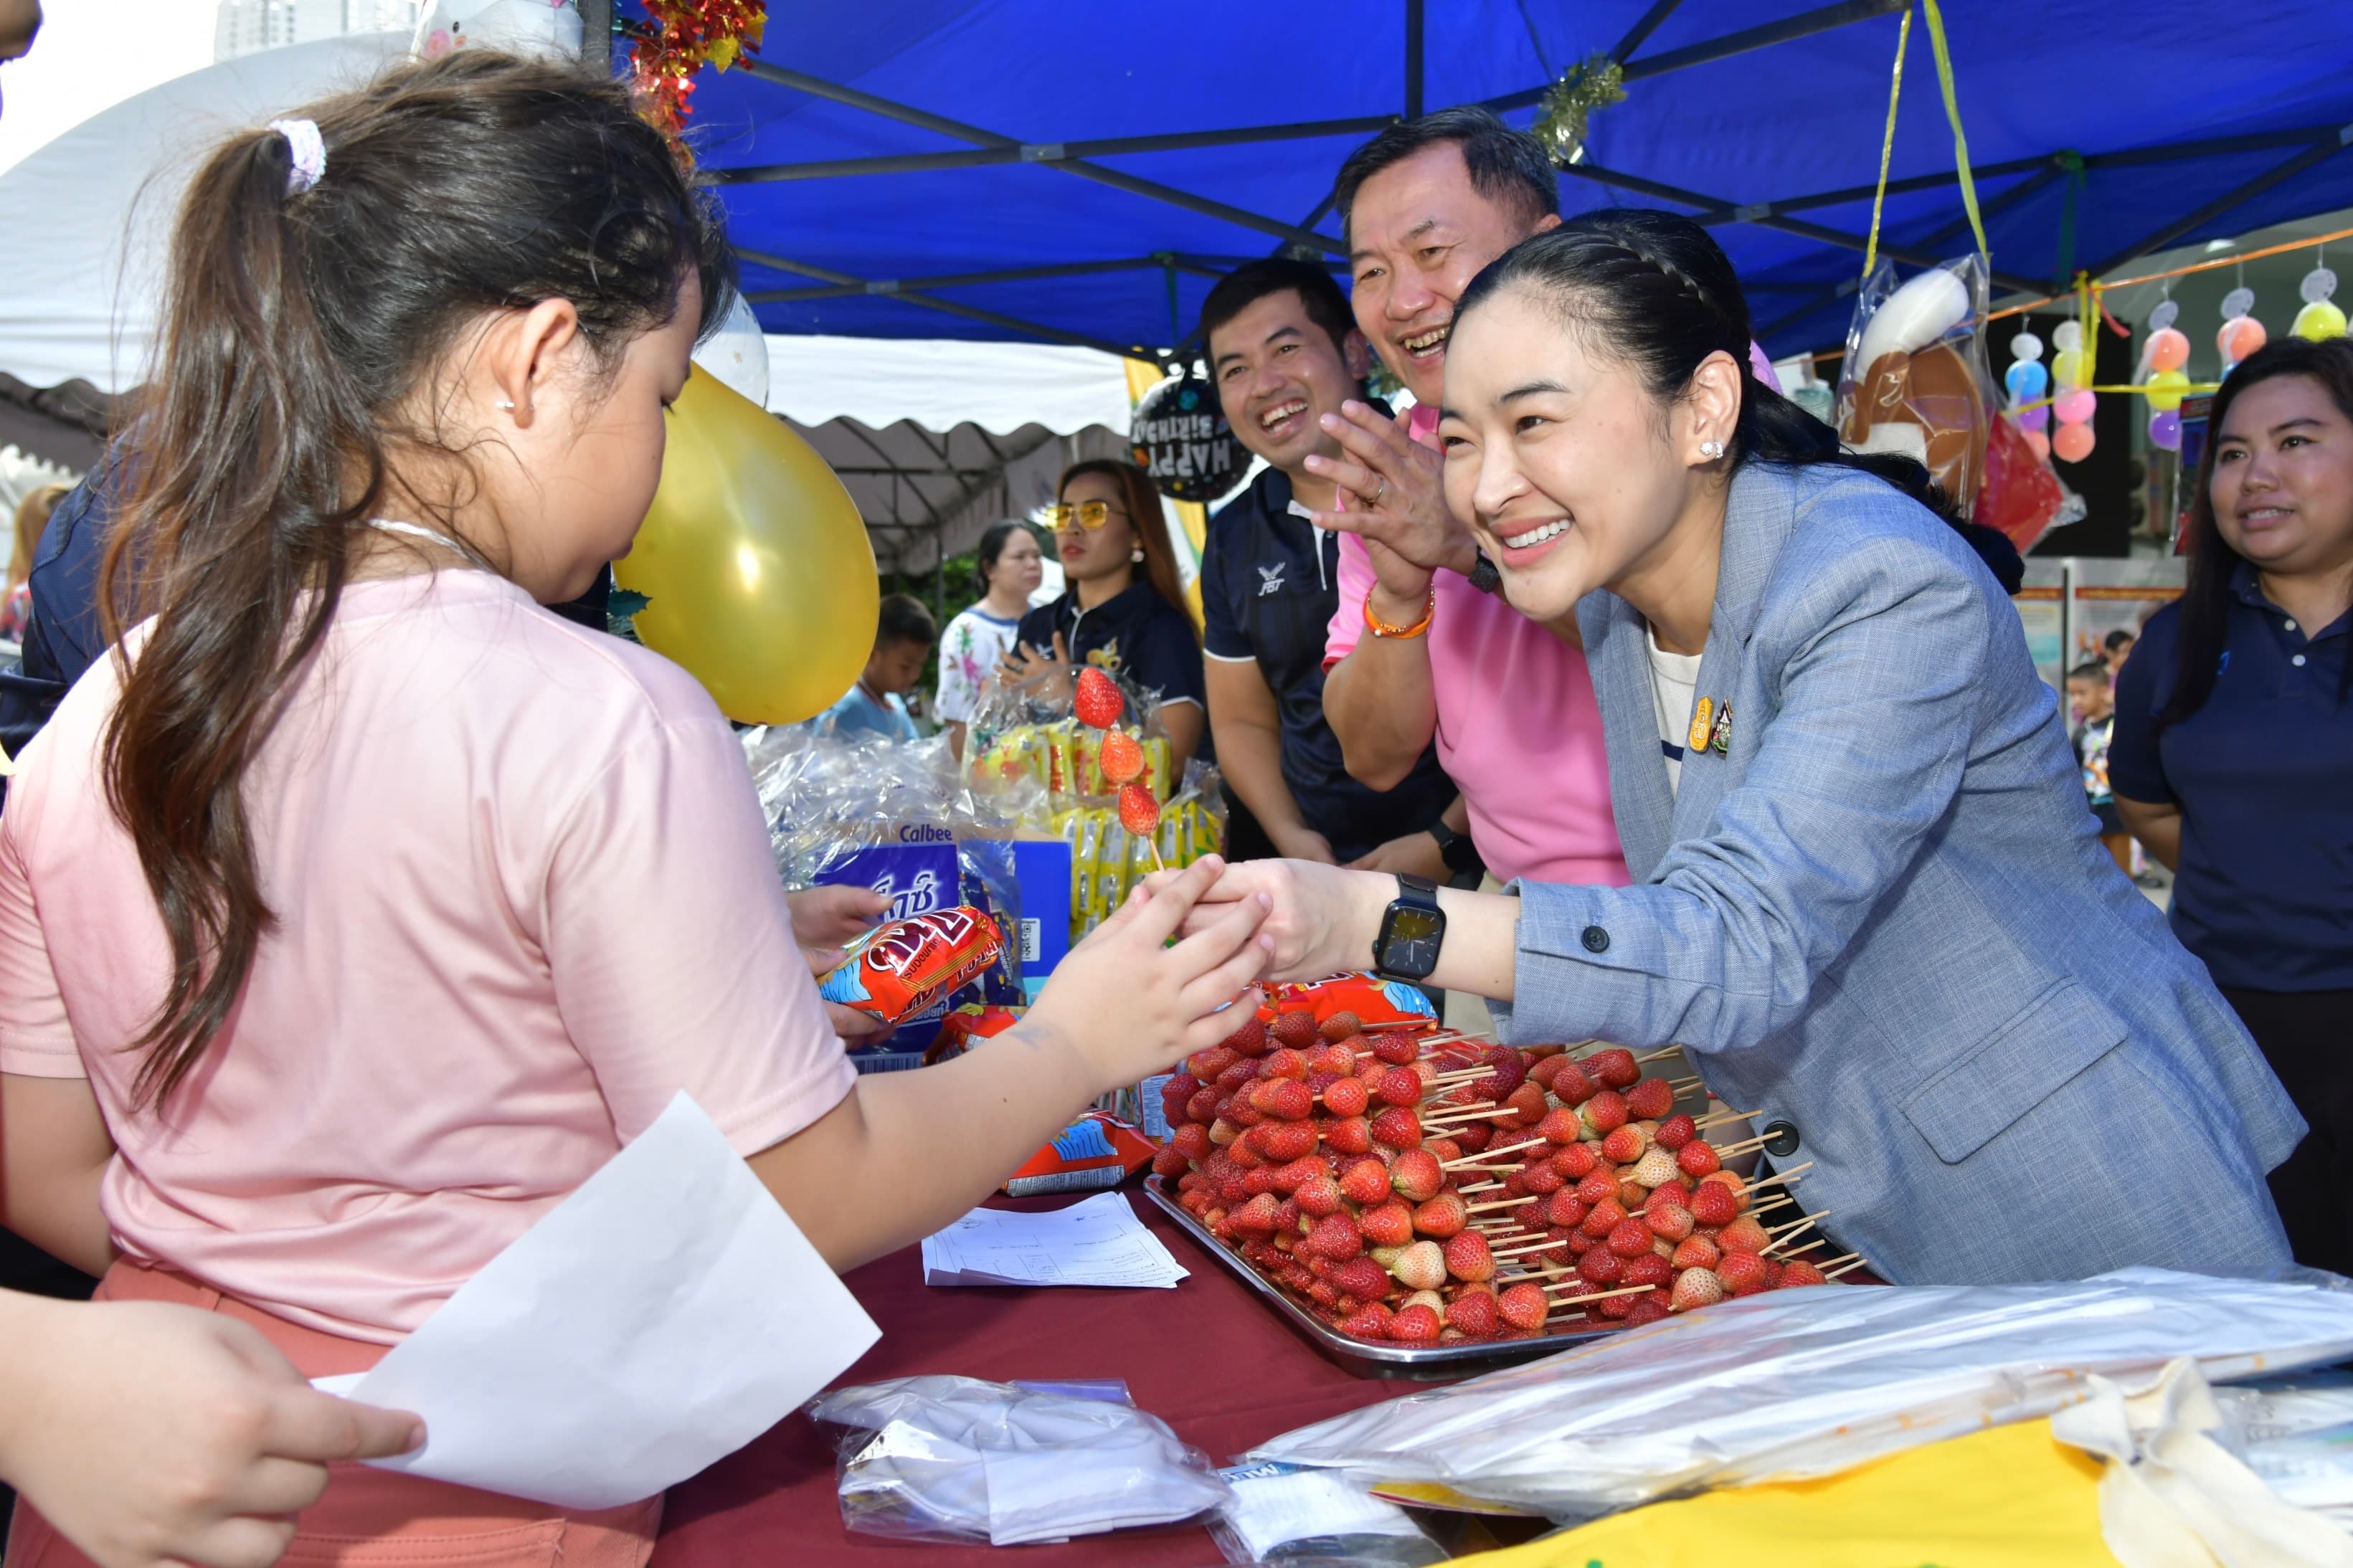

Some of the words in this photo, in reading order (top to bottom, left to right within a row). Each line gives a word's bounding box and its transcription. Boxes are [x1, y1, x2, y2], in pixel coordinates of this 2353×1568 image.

[1146, 439, 1231, 477] HAPPY
[1258, 578, 1285, 597] FBT
[899, 824, 953, 842] Calbee
